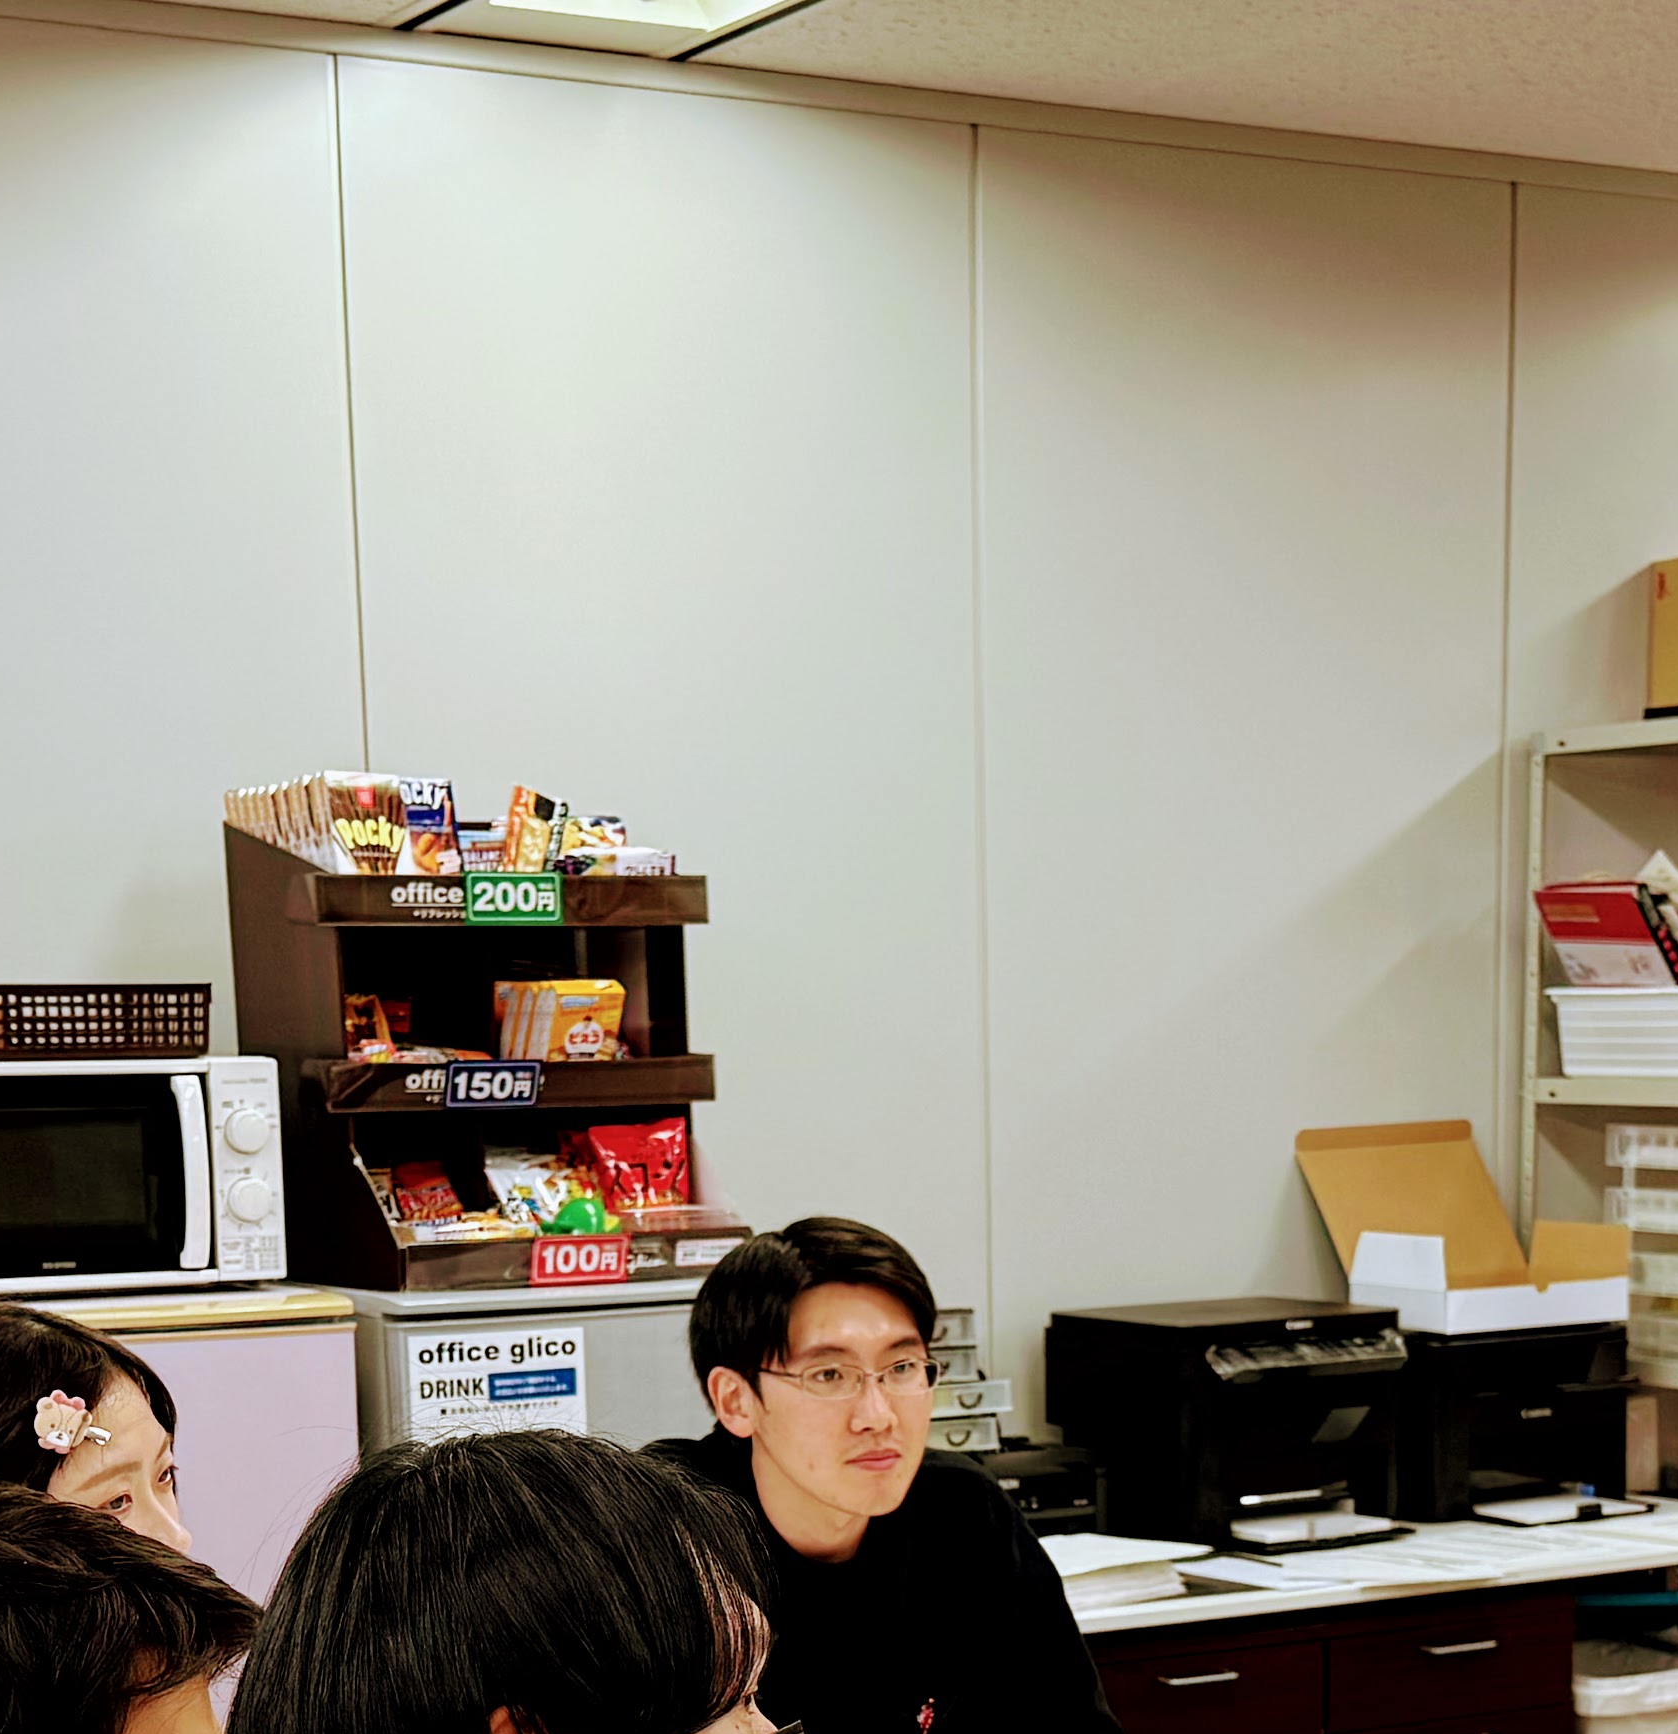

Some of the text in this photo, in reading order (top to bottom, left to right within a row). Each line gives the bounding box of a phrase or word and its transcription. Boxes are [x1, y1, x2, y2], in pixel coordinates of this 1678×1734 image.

[400, 779, 447, 810] ocky
[391, 882, 464, 904] office
[473, 881, 556, 913] 200円
[405, 1069, 445, 1089] offi
[454, 1071, 532, 1101] 150円
[541, 1245, 618, 1273] 100円
[419, 1337, 576, 1364] office glico
[420, 1377, 484, 1400] DRINK
